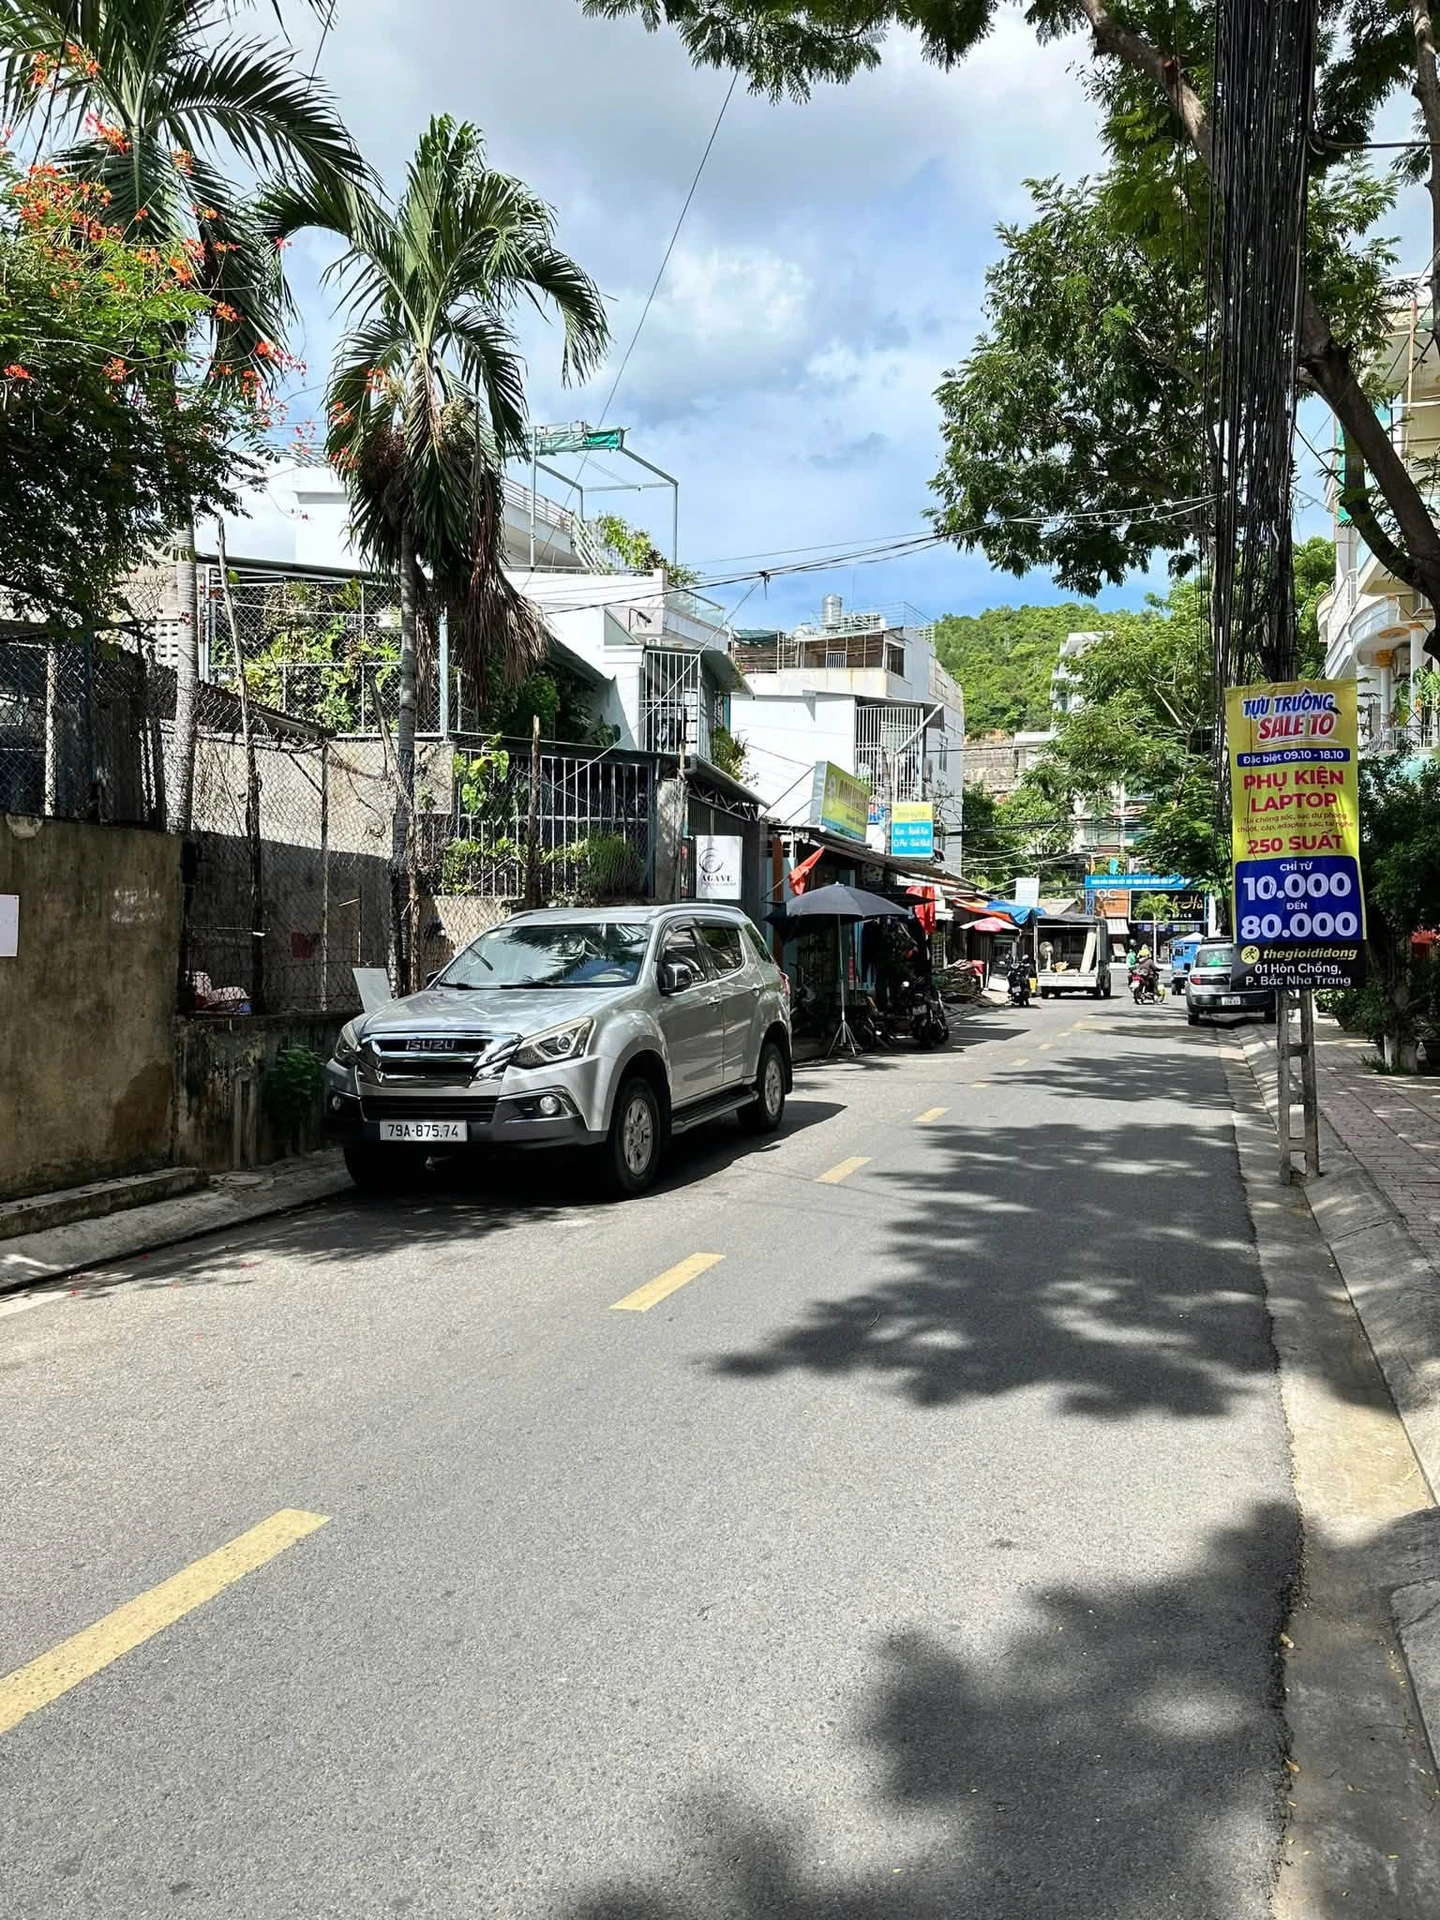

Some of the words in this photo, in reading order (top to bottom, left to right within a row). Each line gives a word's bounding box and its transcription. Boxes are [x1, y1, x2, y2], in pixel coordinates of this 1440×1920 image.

[1243, 697, 1270, 719] TỰU
[1275, 688, 1336, 713] TRƯỜNG
[1259, 714, 1304, 739] SALE
[1310, 713, 1335, 735] TO
[1243, 755, 1261, 764] Đặc
[1262, 754, 1282, 763] biệt
[1283, 751, 1312, 760] 09.10
[1319, 750, 1344, 760] 18.10
[1243, 771, 1288, 791] PHỤ
[1294, 766, 1344, 789] KIỆN
[1250, 792, 1337, 812] LAPTOP
[1247, 837, 1283, 854] 250
[1289, 829, 1343, 850] SUẤT
[1279, 861, 1297, 871] CHỈ
[1299, 861, 1313, 871] TỪ
[1242, 872, 1352, 900] 10.000
[1286, 900, 1308, 910] ĐẾN
[1240, 911, 1358, 940] 80.000
[1263, 948, 1358, 961] thegioididong
[1254, 963, 1267, 973] 01
[1270, 963, 1295, 973] Hòn
[1245, 976, 1257, 986] P.
[1260, 973, 1283, 986] Bắc
[1286, 976, 1312, 985] Nha
[1315, 975, 1351, 986] Trang
[405, 1040, 456, 1050] ISUZU
[387, 1124, 459, 1138] 79A-875.74
